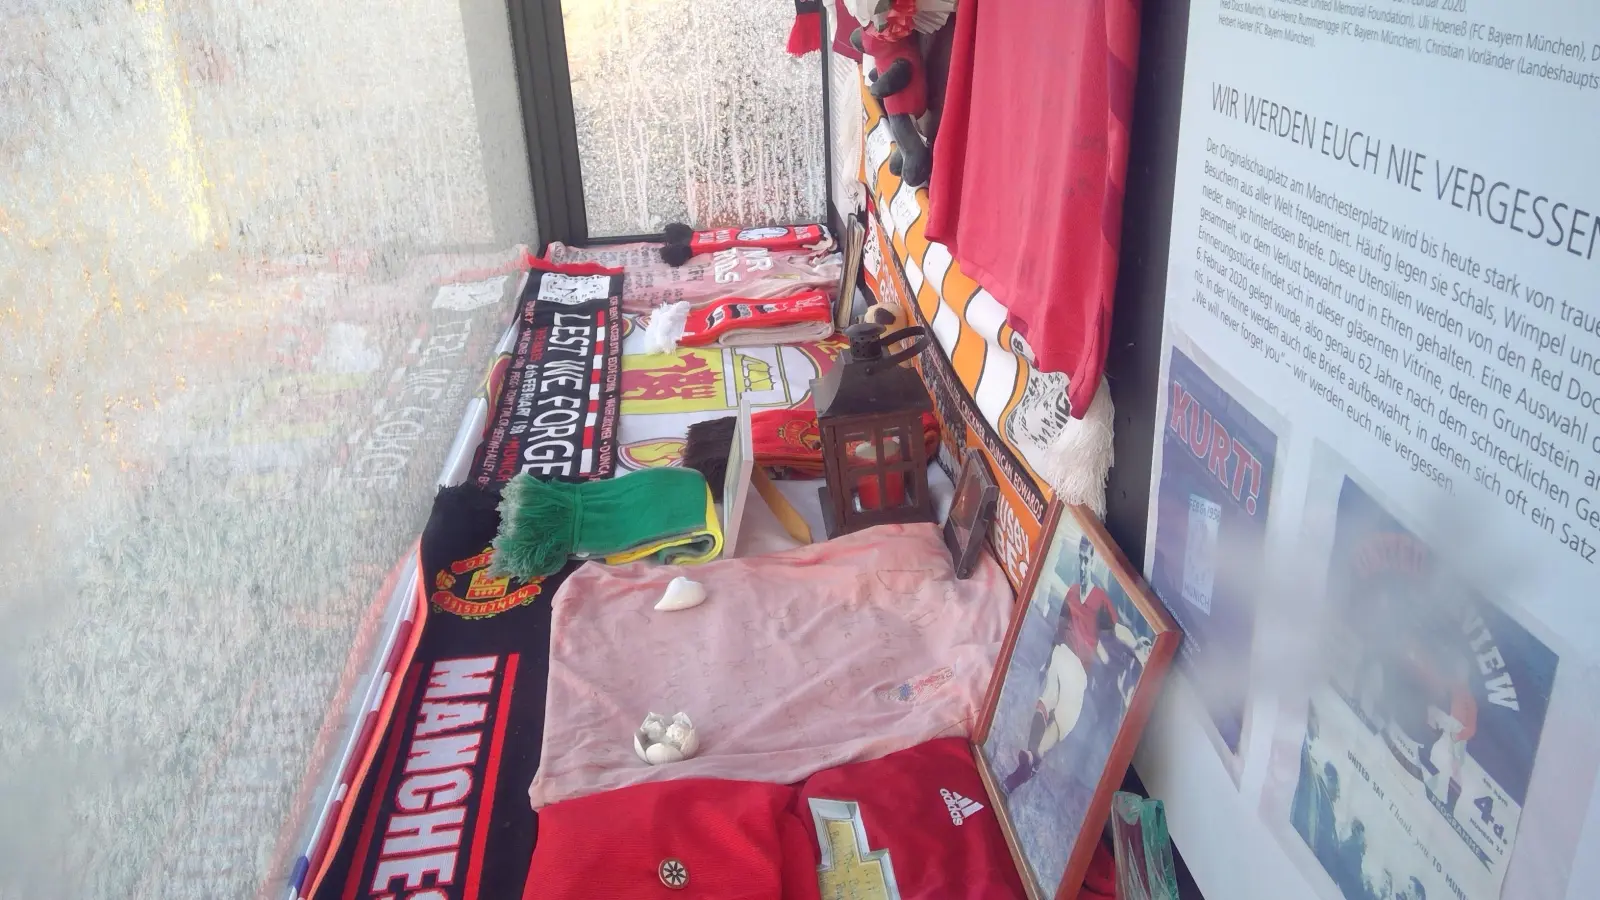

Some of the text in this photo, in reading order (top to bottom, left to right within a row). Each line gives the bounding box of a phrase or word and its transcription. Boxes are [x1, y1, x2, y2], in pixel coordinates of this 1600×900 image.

[1264, 23, 1283, 40] Bayern
[1299, 12, 1340, 35] Rummenigge
[1354, 23, 1379, 43] Bayern
[1425, 37, 1465, 61] Christian
[1467, 46, 1516, 71] Vorländer
[1334, 0, 1367, 18] Memorial
[1418, 15, 1429, 30] Uli
[1470, 22, 1486, 41] (FC
[1487, 26, 1523, 48] Bayern
[1526, 33, 1586, 62] München),
[1211, 81, 1239, 119] WIR
[1244, 92, 1316, 149] WERDEN
[1321, 120, 1381, 174] EUCH
[1386, 143, 1427, 193] NIE
[1202, 183, 1224, 209] nieder,
[1225, 197, 1248, 221] einige
[1248, 203, 1295, 246] hinterlassen
[1298, 232, 1326, 262] Briefe.
[1328, 248, 1356, 279] Diese
[1358, 264, 1413, 310] Utensilien
[1415, 299, 1463, 338] werden
[1467, 327, 1493, 354] von
[1497, 341, 1526, 372] den
[1531, 358, 1564, 393] Red
[1204, 159, 1240, 190] Besuchern
[1240, 179, 1254, 198] aus
[1254, 185, 1272, 207] aller
[1274, 193, 1294, 217] Welt
[1295, 203, 1352, 249] frequentiert.
[1356, 234, 1392, 271] Häufig
[1395, 252, 1427, 287] legen
[1430, 273, 1448, 296] sie
[1451, 282, 1498, 325] Schals,
[1504, 305, 1567, 357] Wimpel
[1206, 137, 1219, 155] Der
[1219, 143, 1288, 189] Originalschauplatz
[1290, 176, 1304, 196] am
[1306, 181, 1389, 236] Manchesterplatz
[1391, 224, 1418, 248] wird
[1420, 231, 1438, 259] bis
[1441, 241, 1480, 279] heute
[1484, 266, 1521, 299] stark
[1526, 286, 1555, 314] von
[540, 359, 586, 393] WE
[547, 311, 592, 357] LEST
[1198, 223, 1260, 276] Erinnerungsstücke
[1261, 262, 1285, 292] findet
[1287, 281, 1304, 301] sich
[1305, 292, 1314, 310] in
[1316, 297, 1345, 329] dieser
[1346, 318, 1399, 364] gläsernen
[1402, 347, 1444, 396] Vitrine,
[1449, 381, 1488, 420] deren
[1492, 407, 1580, 478] Grundstein
[1200, 205, 1238, 241] gesammelt,
[1240, 228, 1253, 245] vor
[1253, 233, 1271, 257] dem
[1273, 244, 1301, 276] Verlust
[1303, 261, 1343, 300] bewahrt
[1344, 288, 1365, 313] und
[1367, 298, 1378, 321] in
[1380, 307, 1413, 342] Ehren
[1416, 330, 1476, 379] gehalten.
[1480, 364, 1512, 400] Eine
[1515, 387, 1589, 445] Auswahl
[1203, 249, 1228, 278] Februar
[1229, 267, 1248, 291] 2020
[1248, 283, 1273, 310] gelegt
[1274, 299, 1302, 331] wurde,
[1304, 319, 1323, 342] also
[1325, 333, 1356, 364] genau
[1358, 352, 1372, 375] 62
[1373, 363, 1404, 396] Jahre
[1406, 387, 1436, 418] nach
[1438, 406, 1468, 440] dem
[1470, 430, 1570, 509] schrecklichen
[1575, 497, 1600, 534] Ge
[1170, 380, 1262, 516] KURT!
[1194, 268, 1597, 565] nis. In der Vitrine werden auch die Briefe aufbewahrt, in denen sich oft ein Satz
[1207, 298, 1220, 319] will
[1220, 310, 1240, 333] never
[1240, 321, 1264, 352] forget
[1293, 364, 1308, 384] wir
[1309, 375, 1345, 413] werden
[1346, 402, 1372, 433] euch
[1374, 423, 1392, 448] nie
[1394, 437, 1456, 497] vergessen.
[989, 438, 1014, 482] DUNCAN
[1013, 471, 1045, 521] EDWARDS
[367, 655, 500, 900] MANCHE
[939, 788, 963, 827] adidas
[1347, 750, 1371, 782] UNITED
[1372, 780, 1385, 801] SAY
[1432, 855, 1443, 873] TO
